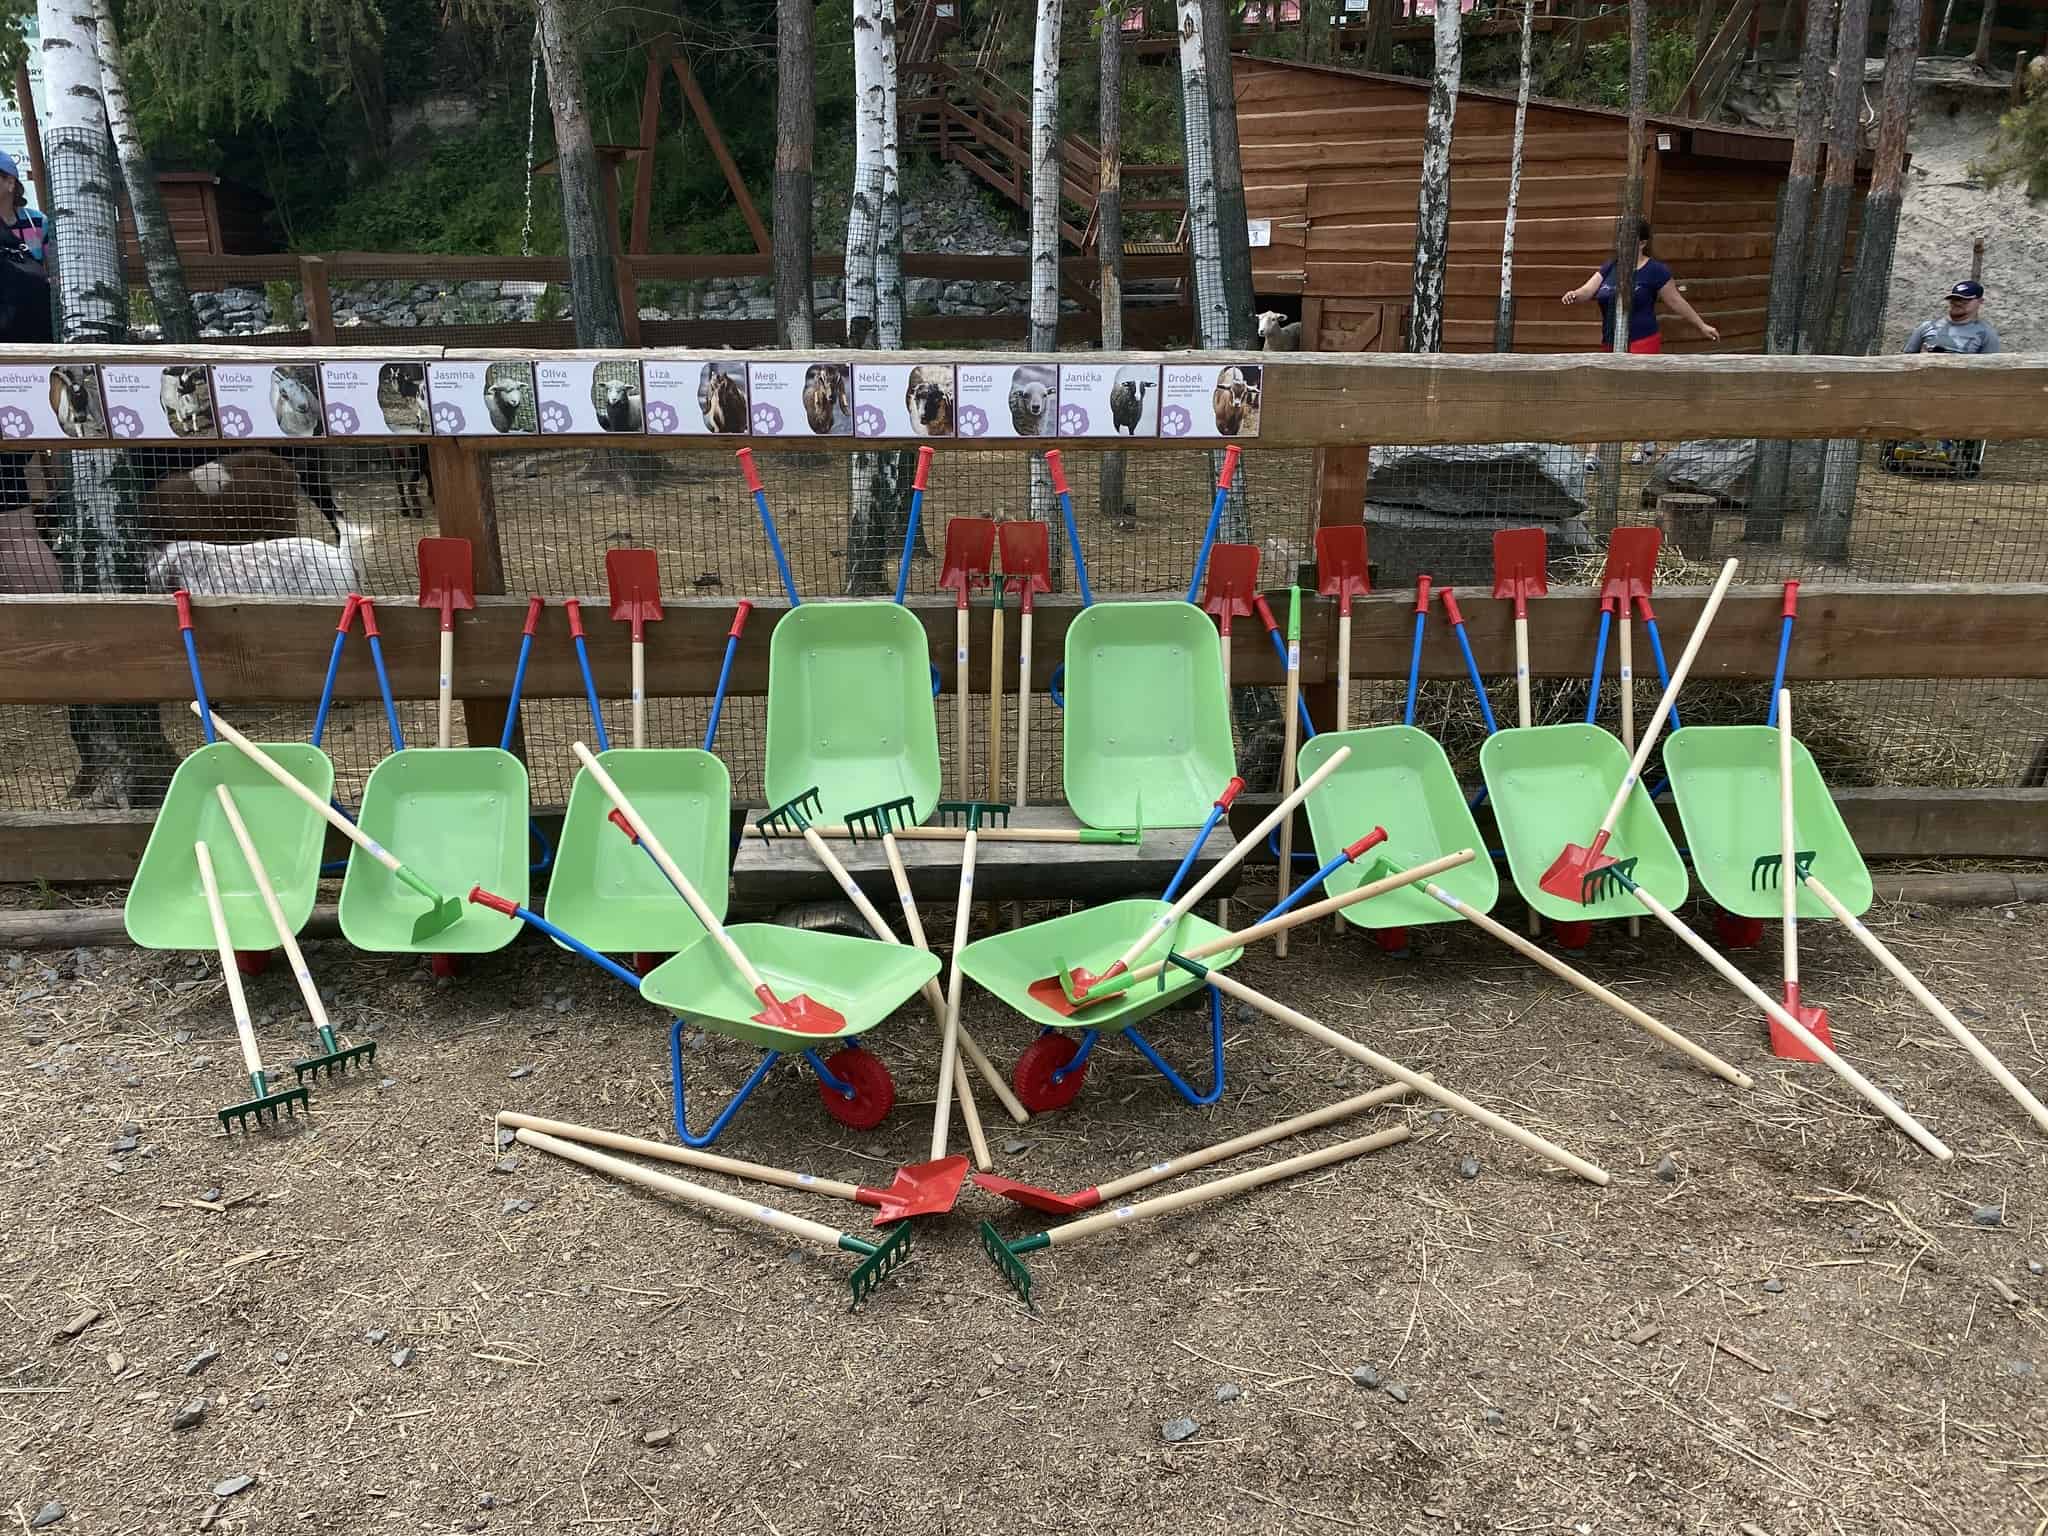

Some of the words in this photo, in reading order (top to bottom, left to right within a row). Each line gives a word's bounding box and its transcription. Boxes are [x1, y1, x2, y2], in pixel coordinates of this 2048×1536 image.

[218, 372, 252, 383] Vločka
[434, 370, 475, 380] Jasmina
[541, 368, 567, 378] Oliva
[755, 370, 777, 382] Megi
[1066, 371, 1102, 382] Janička
[1168, 372, 1203, 383] Drobek
